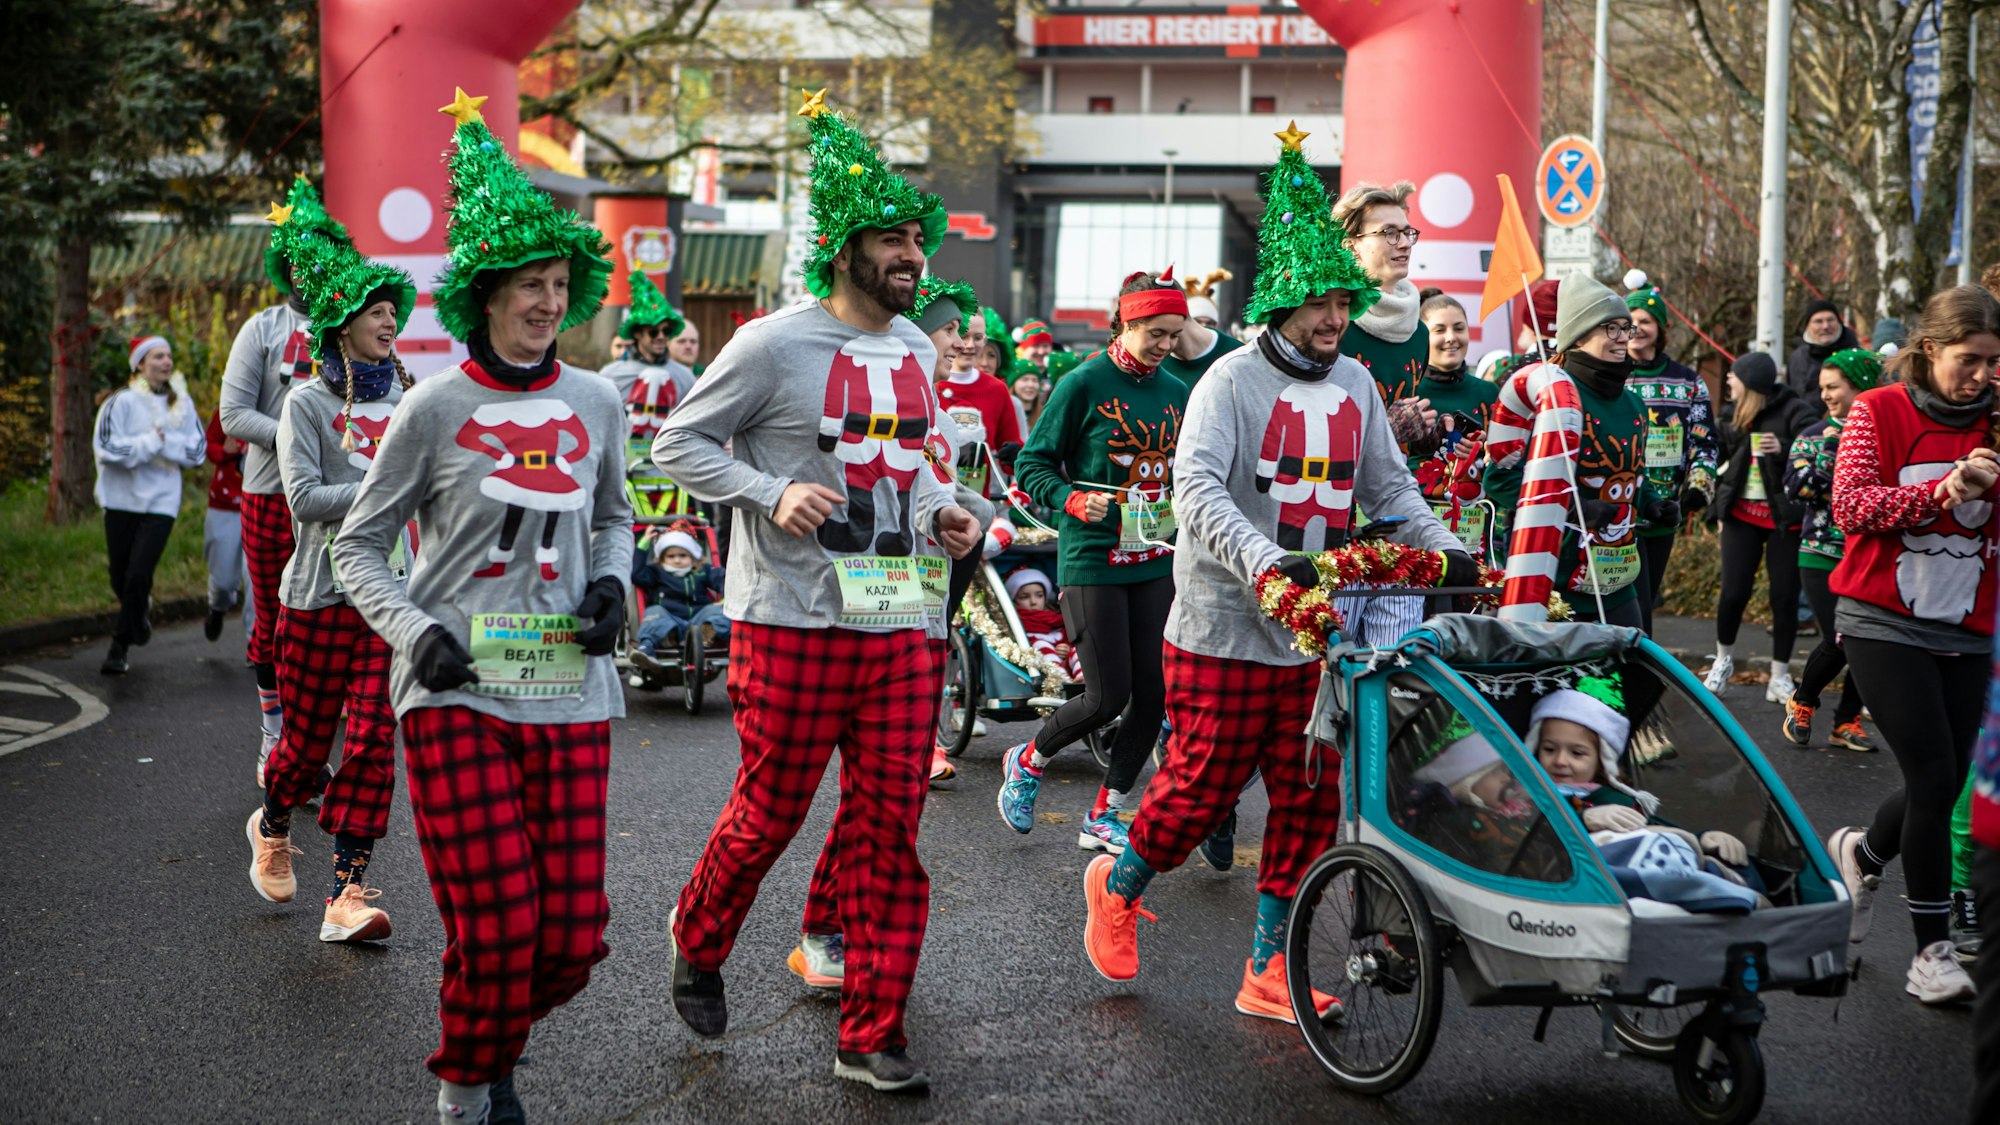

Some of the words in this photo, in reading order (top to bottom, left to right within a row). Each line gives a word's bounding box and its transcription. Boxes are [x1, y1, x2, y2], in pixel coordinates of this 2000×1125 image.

[1083, 17, 1152, 44] HIER
[1155, 17, 1278, 44] REGIERT
[1596, 549, 1620, 557] UGLY
[843, 558, 875, 570] UGLY
[877, 558, 908, 570] XMAS
[922, 557, 943, 569] XMAS
[887, 570, 911, 582] RUN
[927, 568, 943, 579] RUN
[1602, 566, 1629, 575] KATRIN
[865, 585, 899, 597] KAZIM
[921, 580, 936, 591] SSA
[878, 600, 891, 612] 27
[483, 615, 530, 629] UGLY
[532, 617, 575, 630] XMAS
[542, 630, 577, 646] RUN
[504, 648, 556, 662] BEATE
[519, 666, 536, 680] 21
[1506, 910, 1577, 938] Qeridoo
